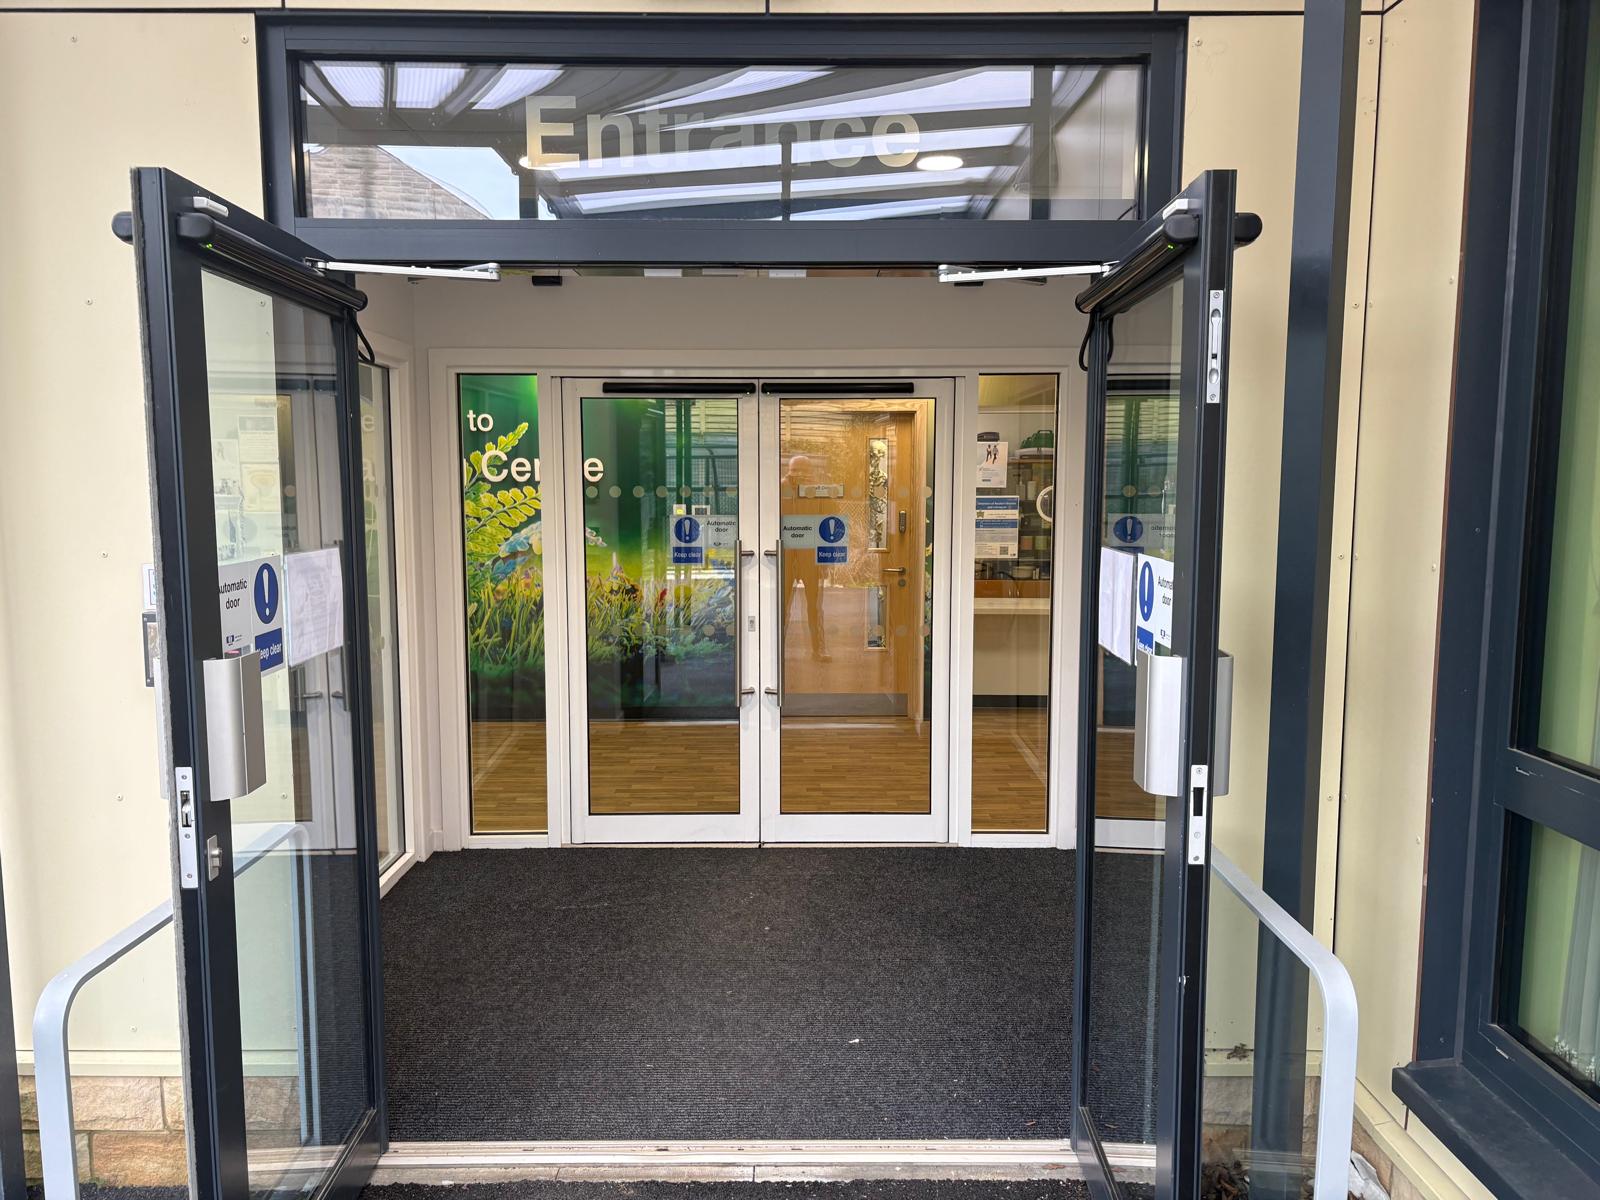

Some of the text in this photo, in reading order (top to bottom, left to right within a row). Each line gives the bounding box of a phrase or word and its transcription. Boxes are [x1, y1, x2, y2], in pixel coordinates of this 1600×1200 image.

[525, 95, 920, 169] Entrance
[467, 409, 494, 432] to
[674, 551, 687, 559] Keep
[819, 551, 831, 559] Keep
[225, 598, 241, 610] door
[257, 643, 282, 660] eep clear
